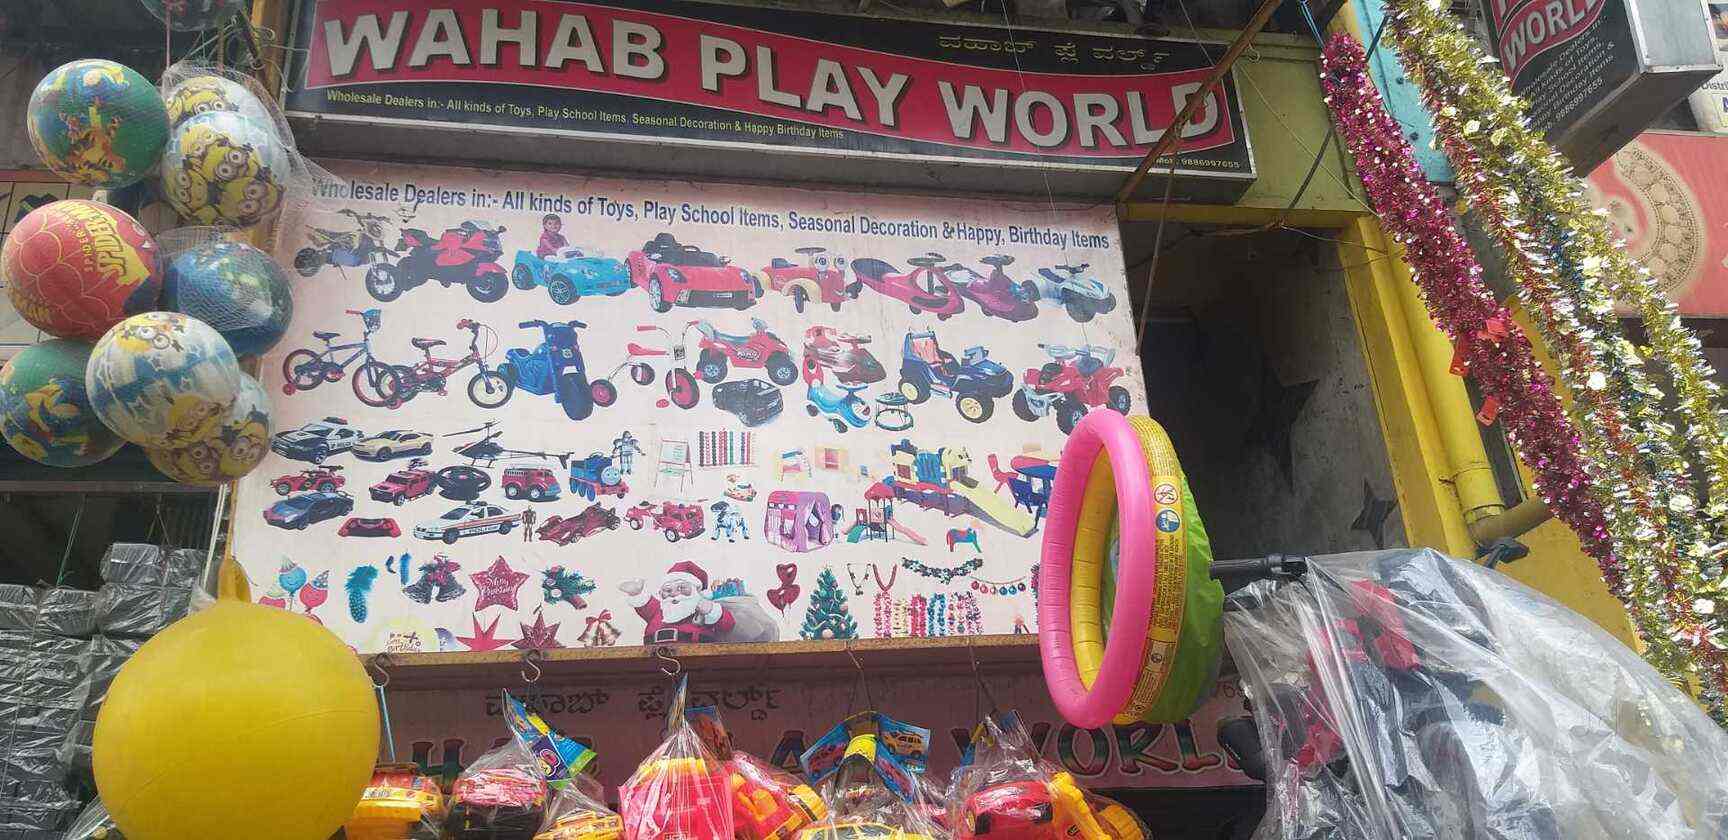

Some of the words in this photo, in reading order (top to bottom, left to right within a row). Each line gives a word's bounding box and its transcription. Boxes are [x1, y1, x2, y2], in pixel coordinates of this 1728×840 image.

[1504, 0, 1597, 70] WORL
[323, 8, 665, 80] WAHAB
[700, 34, 908, 126] PLAY
[938, 80, 1219, 147] WORLD
[326, 88, 382, 105] Wholesale
[384, 94, 424, 108] Dealers
[447, 99, 461, 110] All
[463, 101, 492, 113] kinds
[495, 103, 506, 114] of
[538, 106, 559, 120] Play
[562, 108, 597, 121] School
[632, 113, 677, 127] Seasonal
[680, 117, 732, 131] Decoration
[735, 120, 742, 131] &
[777, 124, 816, 139] Birthday
[819, 128, 844, 138] Items
[312, 178, 399, 202] Wholesale
[404, 183, 466, 208] Dealers
[502, 186, 526, 210] All
[529, 190, 573, 214] kinds
[577, 190, 594, 215] of
[598, 197, 639, 222] Toys,
[643, 200, 677, 225] Play
[681, 201, 734, 225] School
[738, 207, 785, 231] Items,
[788, 210, 855, 235] Seasonal
[860, 216, 938, 239] Decoration
[1009, 225, 1069, 250] Birthday
[1072, 229, 1110, 249] Items
[951, 717, 1243, 777] ORL
